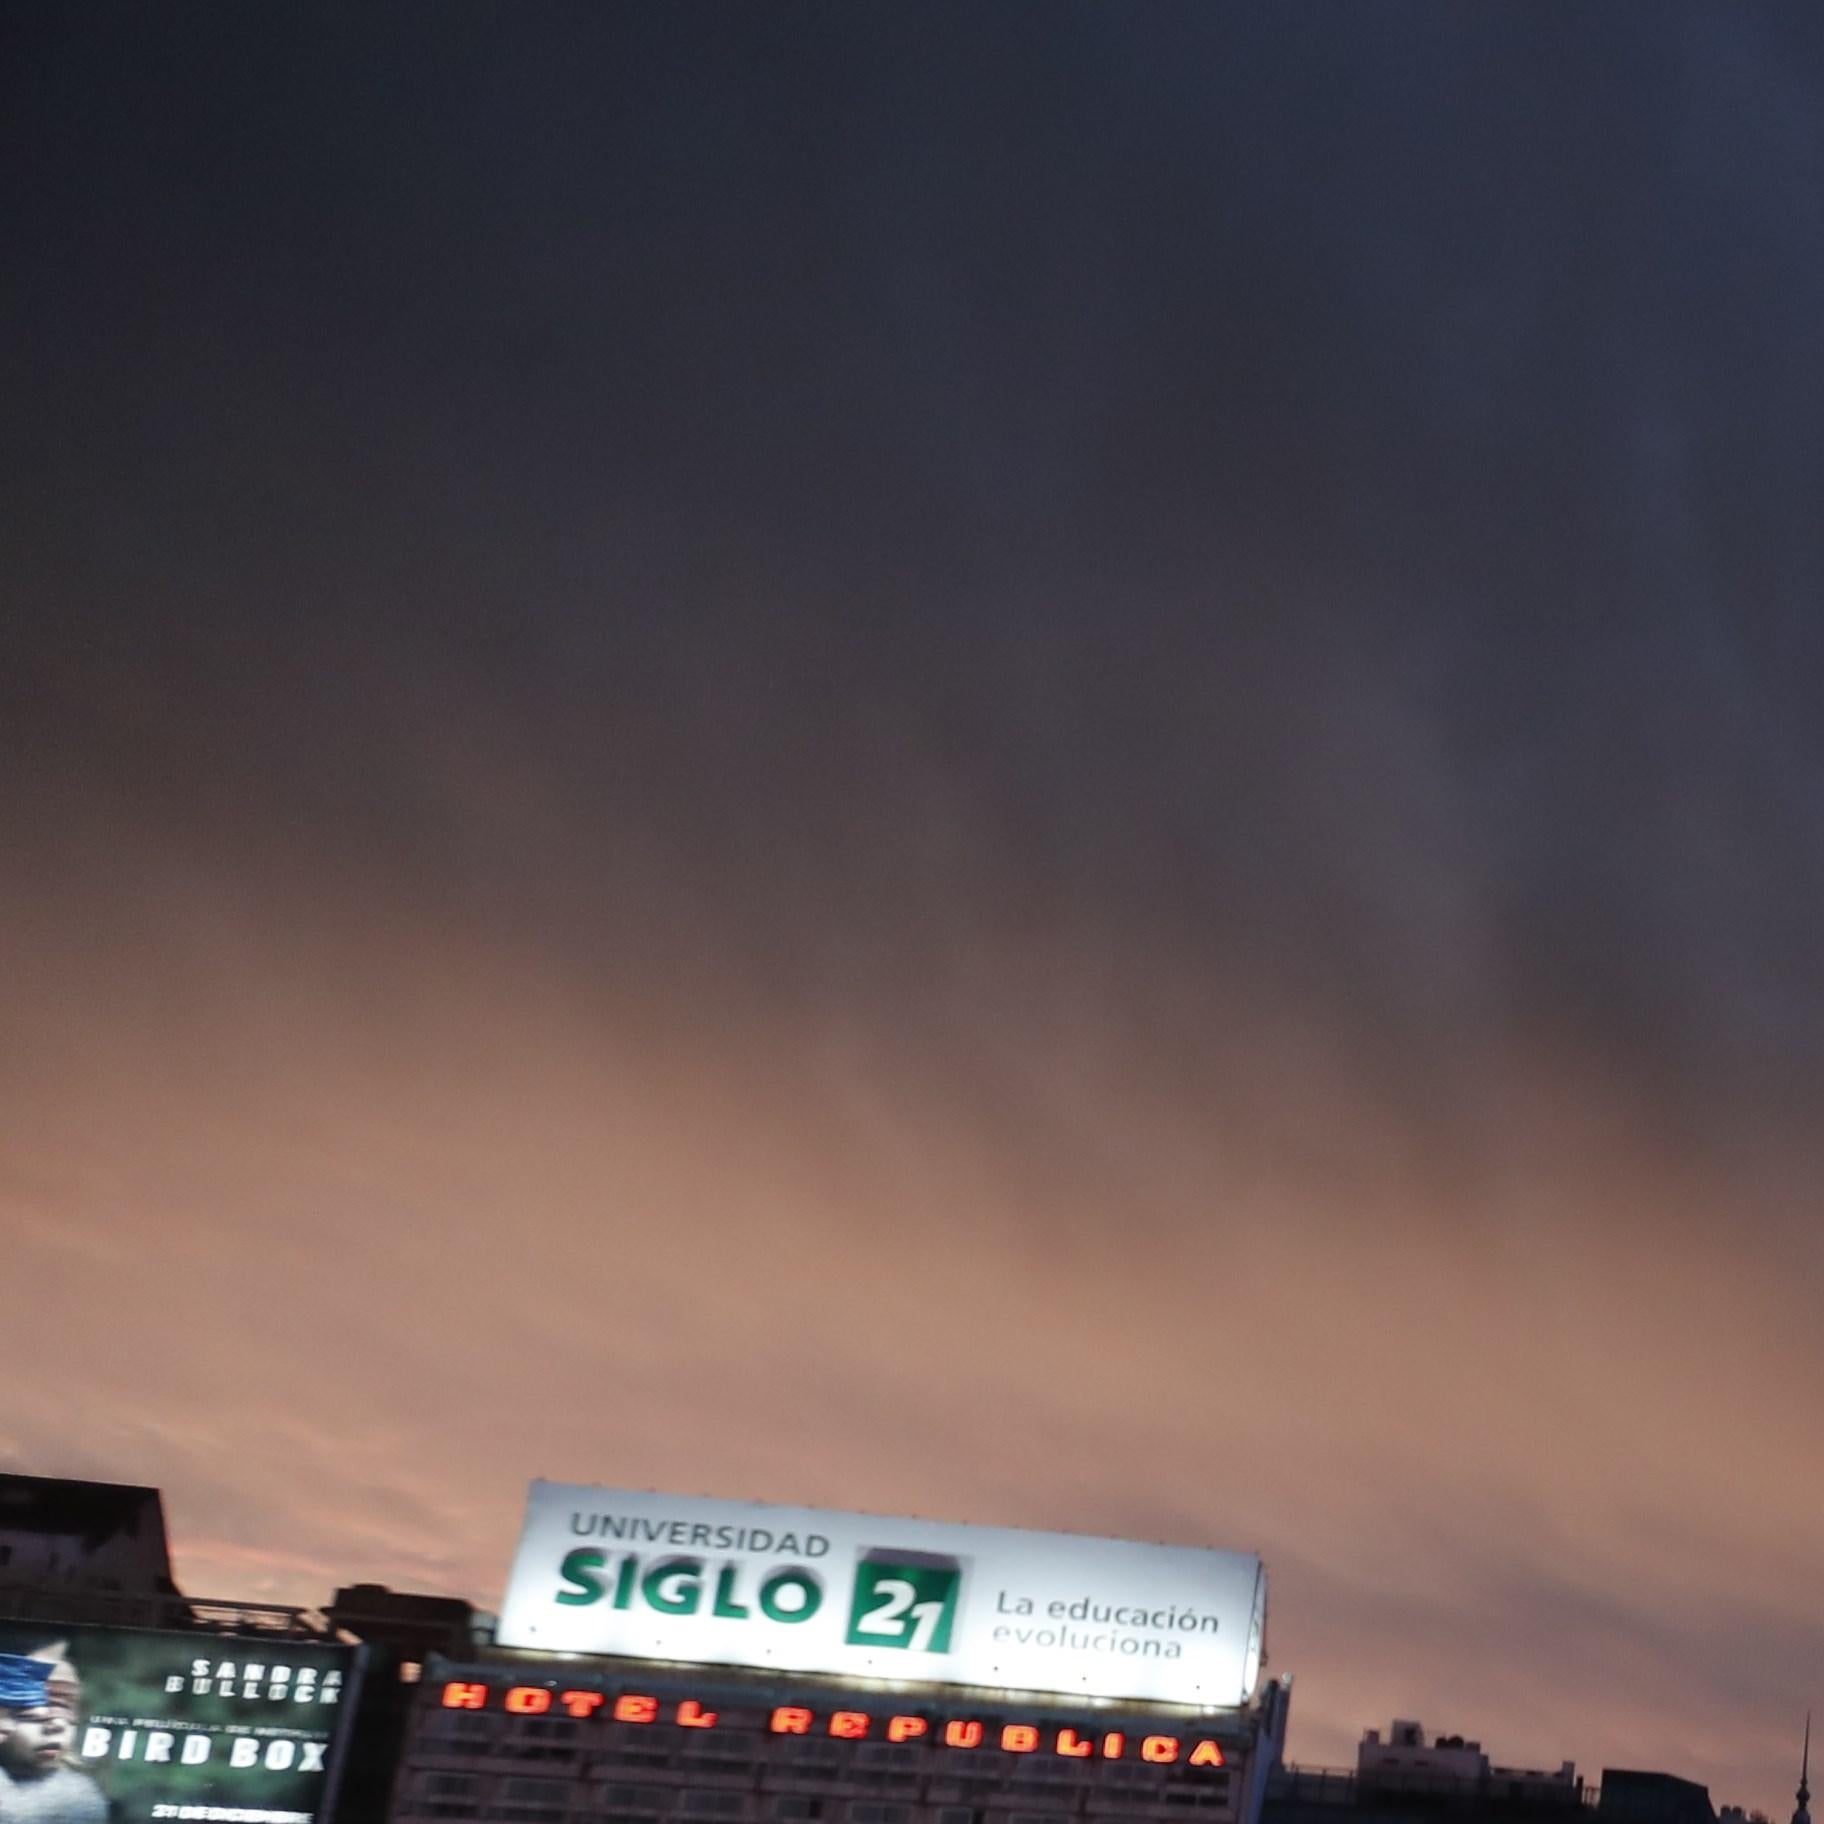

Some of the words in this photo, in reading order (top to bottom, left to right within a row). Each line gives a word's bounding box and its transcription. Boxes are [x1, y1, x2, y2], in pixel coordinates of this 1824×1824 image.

[570, 1511, 830, 1557] UNIVERSIDAD
[555, 1547, 824, 1623] SIGLO
[857, 1578, 943, 1653] 21
[996, 1591, 1035, 1616] La
[1047, 1597, 1220, 1634] educación
[993, 1621, 1182, 1660] evoluciona
[165, 1676, 342, 1704] BULLOCK
[191, 1659, 343, 1686] SANDRA
[442, 1682, 717, 1728] HOTEL
[770, 1706, 1225, 1767] REPUBLICA
[81, 1727, 212, 1765] BIRD
[229, 1737, 328, 1772] BOX
